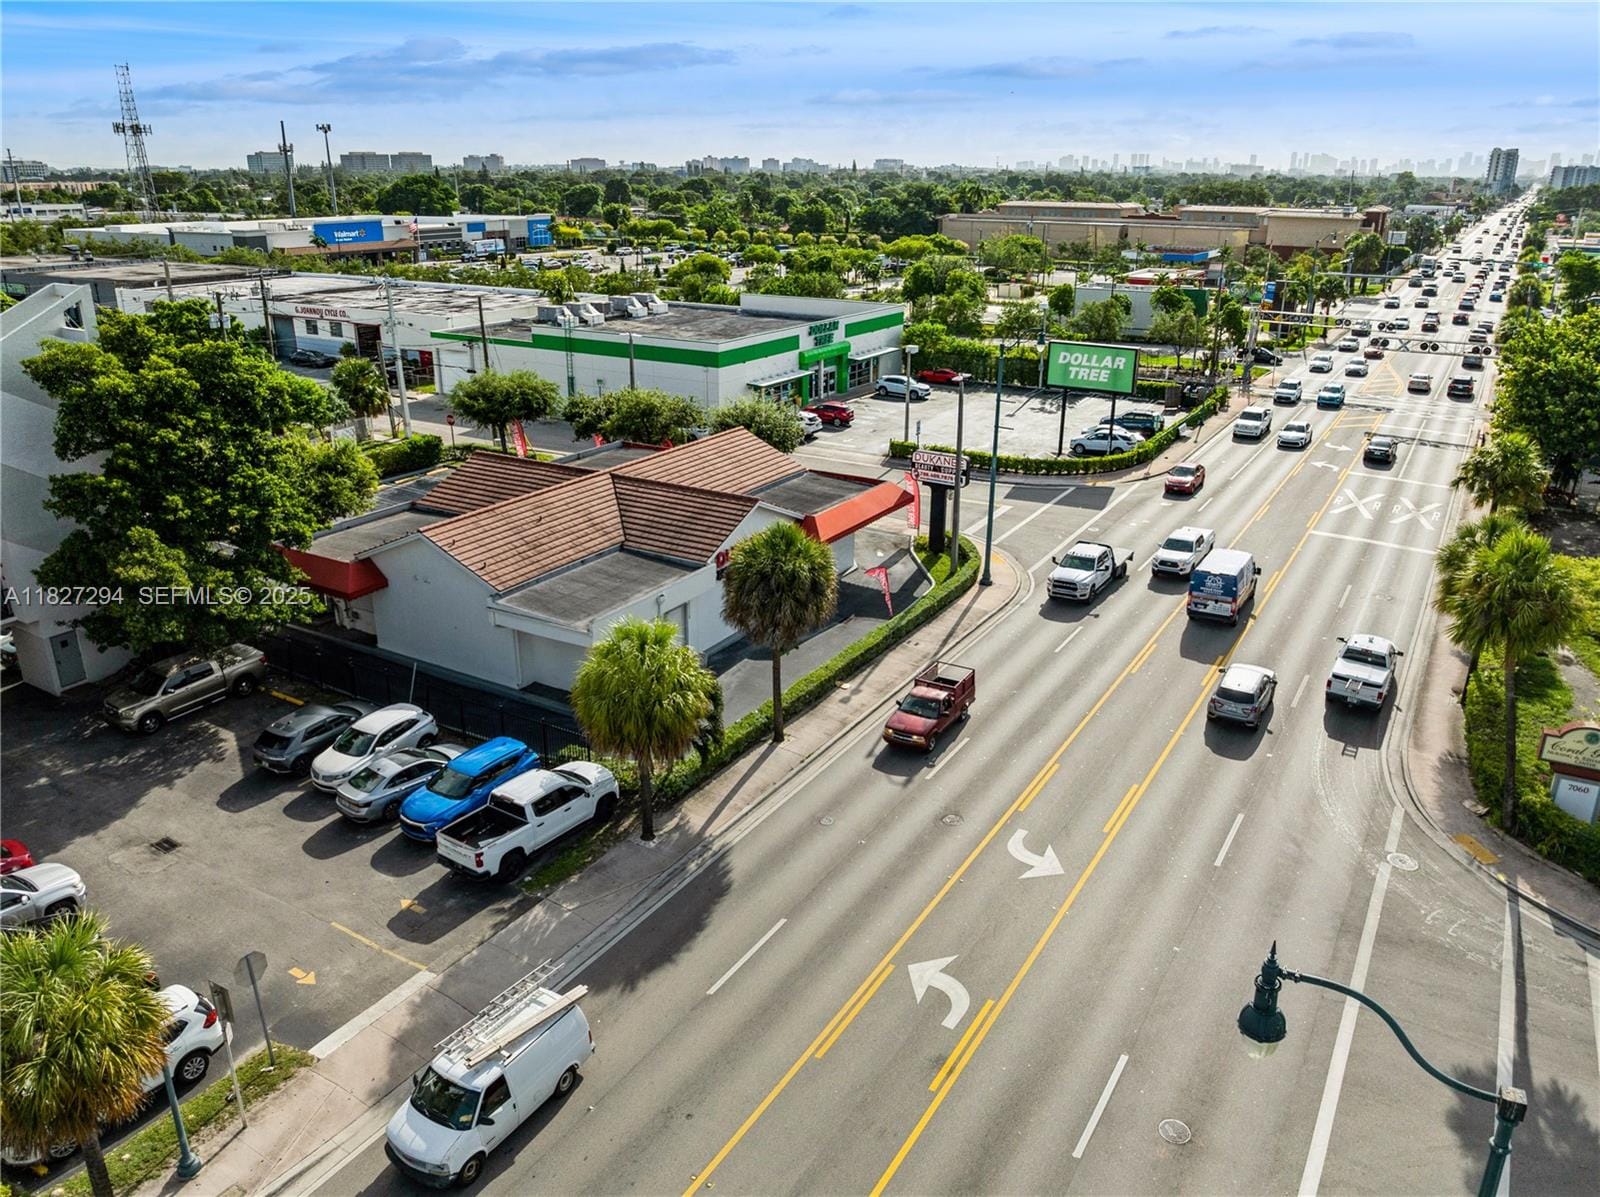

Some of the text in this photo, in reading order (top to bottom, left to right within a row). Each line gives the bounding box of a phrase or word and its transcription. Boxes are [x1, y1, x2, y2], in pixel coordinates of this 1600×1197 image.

[333, 230, 359, 238] Walmart
[808, 320, 839, 336] DOLLAR
[814, 333, 834, 347] TREE
[1058, 351, 1126, 369] DOLLAR
[1068, 366, 1111, 382] TREE
[1372, 501, 1382, 511] R
[1392, 504, 1402, 514] R
[1431, 511, 1441, 521] R
[1568, 783, 1590, 794] 7060
